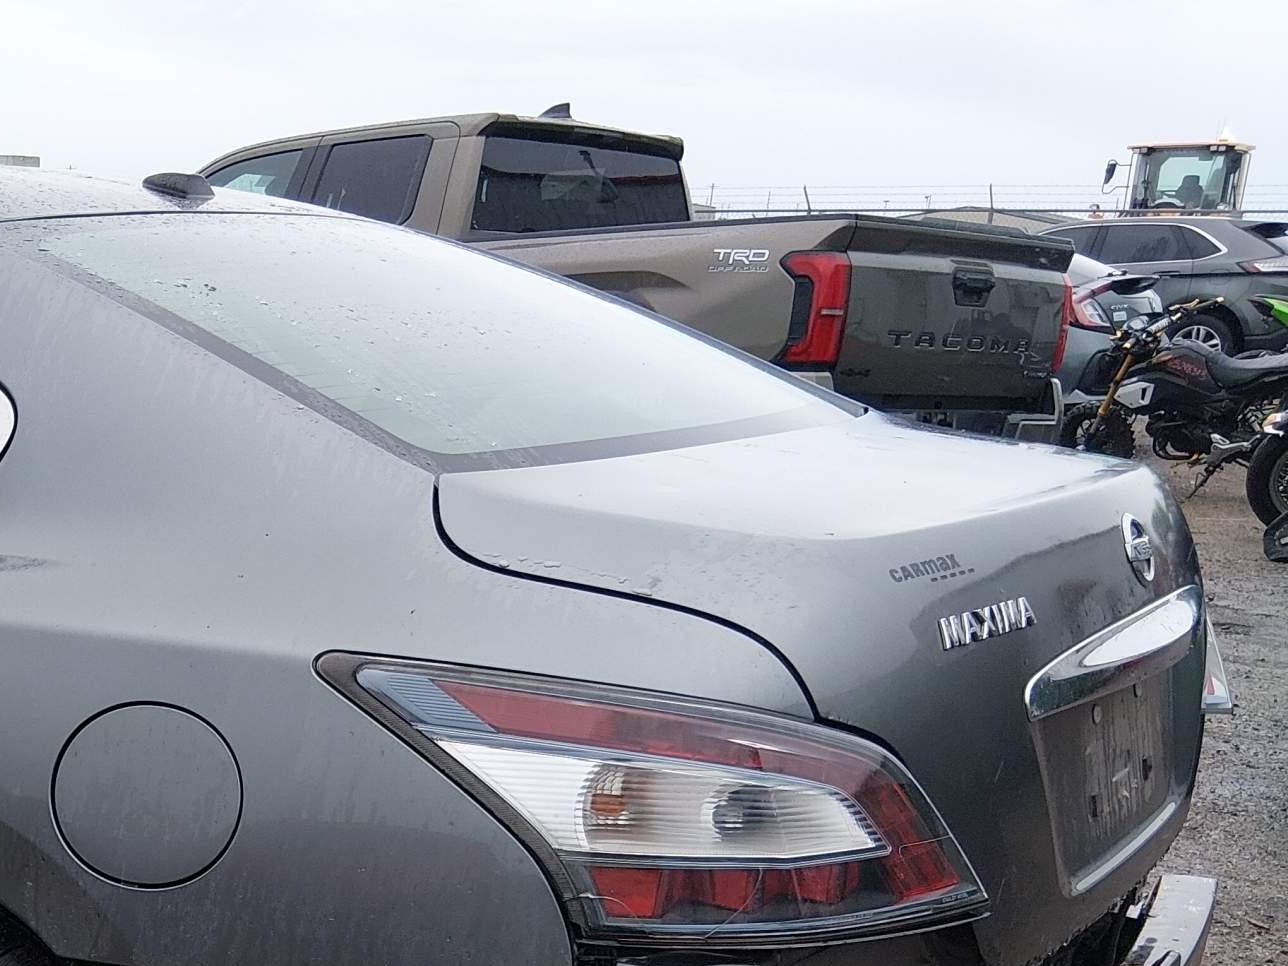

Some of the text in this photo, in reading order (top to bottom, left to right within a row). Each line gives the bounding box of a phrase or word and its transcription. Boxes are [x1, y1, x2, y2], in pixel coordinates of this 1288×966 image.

[713, 248, 770, 265] TRD
[887, 329, 1029, 355] TACOMA
[937, 596, 1037, 651] MAXIMA
